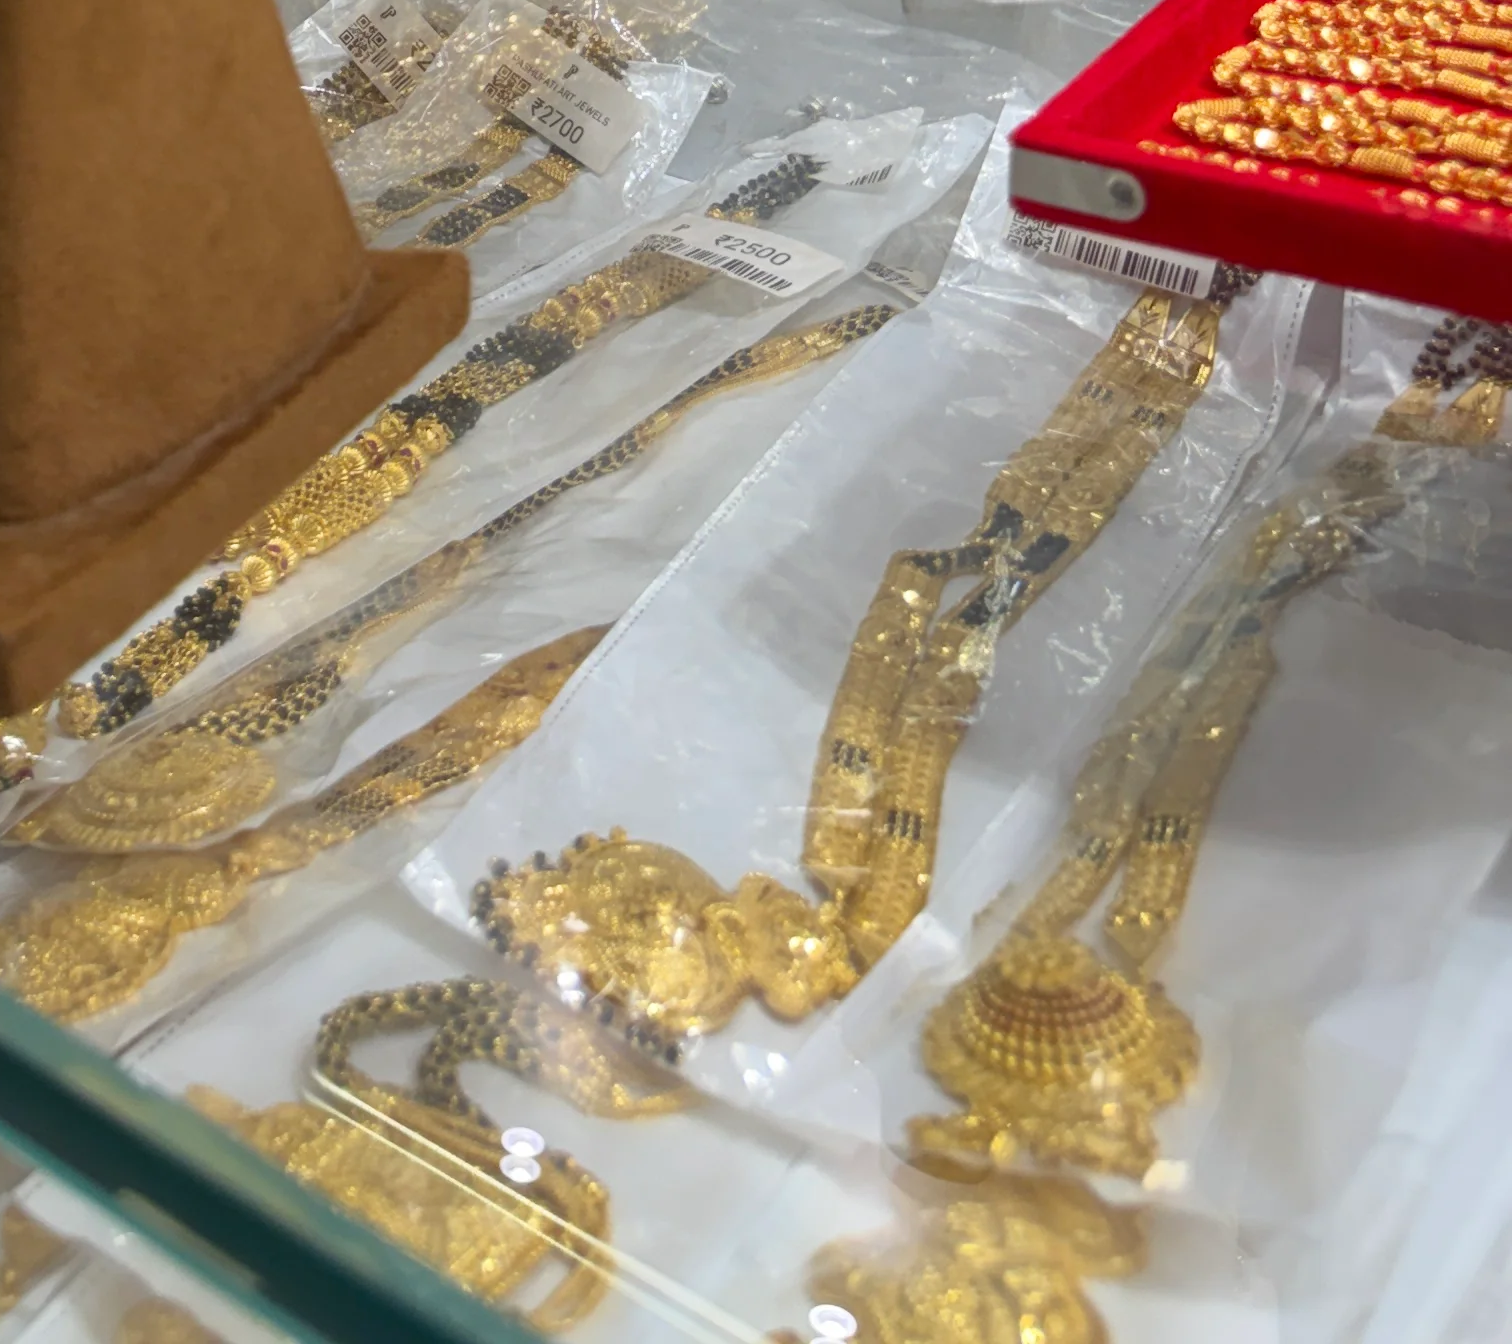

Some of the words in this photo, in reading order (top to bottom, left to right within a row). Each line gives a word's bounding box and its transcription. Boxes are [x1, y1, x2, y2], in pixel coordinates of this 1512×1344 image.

[531, 97, 584, 144] ₹2700
[557, 87, 576, 102] ART
[574, 100, 611, 127] JEWELS
[714, 234, 792, 266] ₹2500
